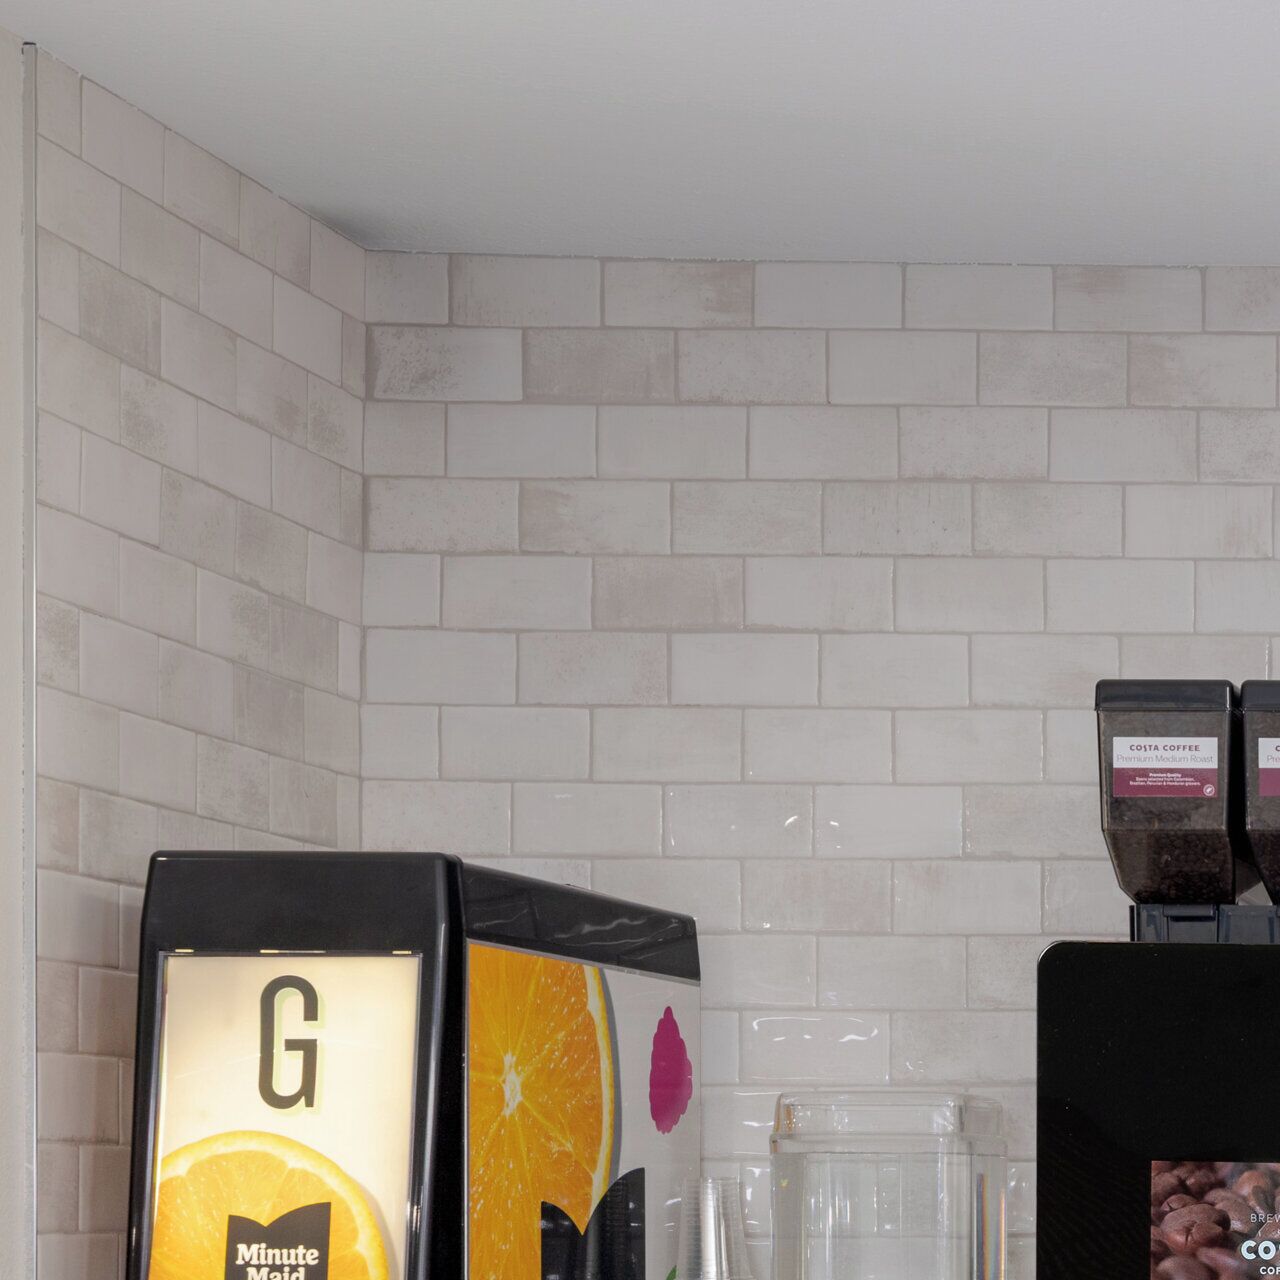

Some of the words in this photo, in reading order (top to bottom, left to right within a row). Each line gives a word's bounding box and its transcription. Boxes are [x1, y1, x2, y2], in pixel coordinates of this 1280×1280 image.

[1129, 744, 1160, 752] COSTA
[1162, 744, 1201, 752] COFFEE
[1117, 754, 1154, 763] Premium
[1155, 754, 1189, 763] Medium
[1190, 754, 1214, 763] Roast
[260, 975, 319, 1109] G
[235, 1242, 319, 1265] Minute
